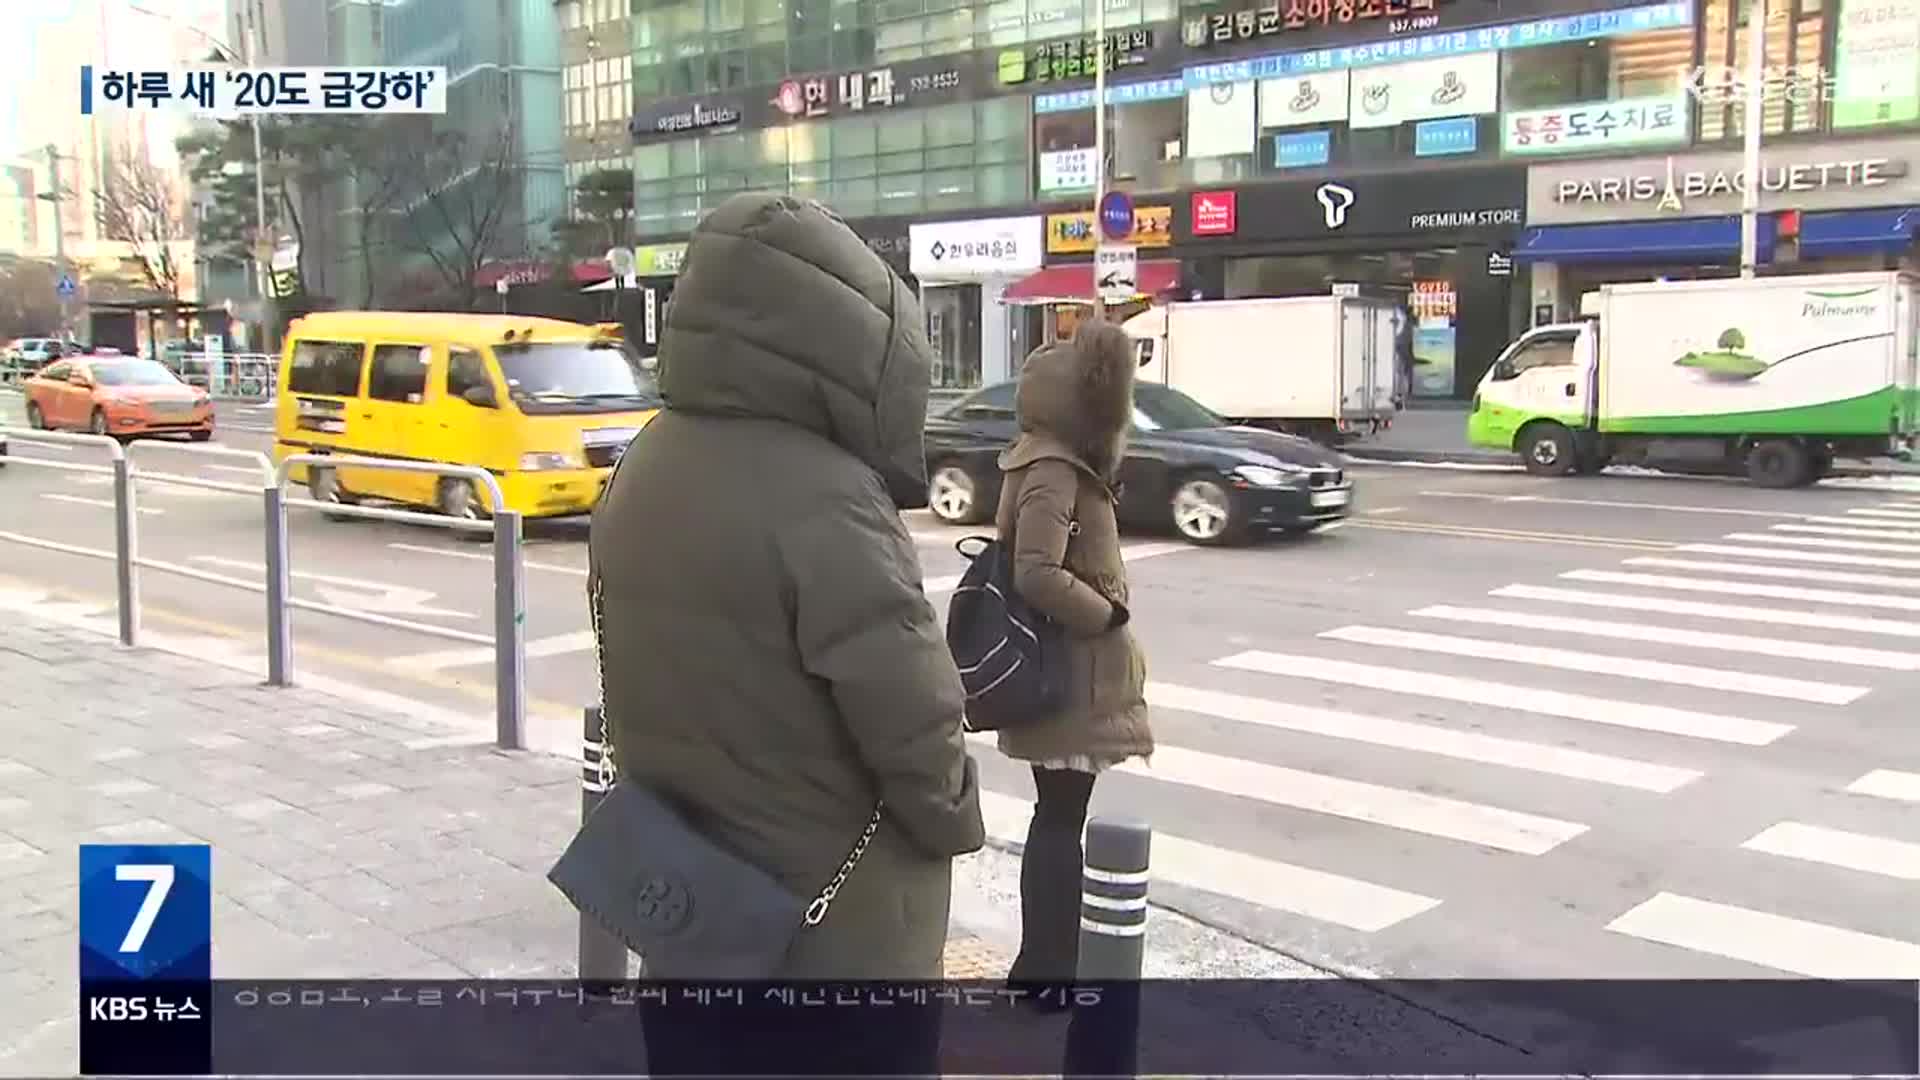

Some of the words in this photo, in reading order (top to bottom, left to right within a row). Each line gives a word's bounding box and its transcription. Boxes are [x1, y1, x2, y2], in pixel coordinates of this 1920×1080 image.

[1558, 176, 1656, 204] PARIS
[1411, 211, 1476, 229] PREMIUM
[1477, 208, 1522, 225] STORE
